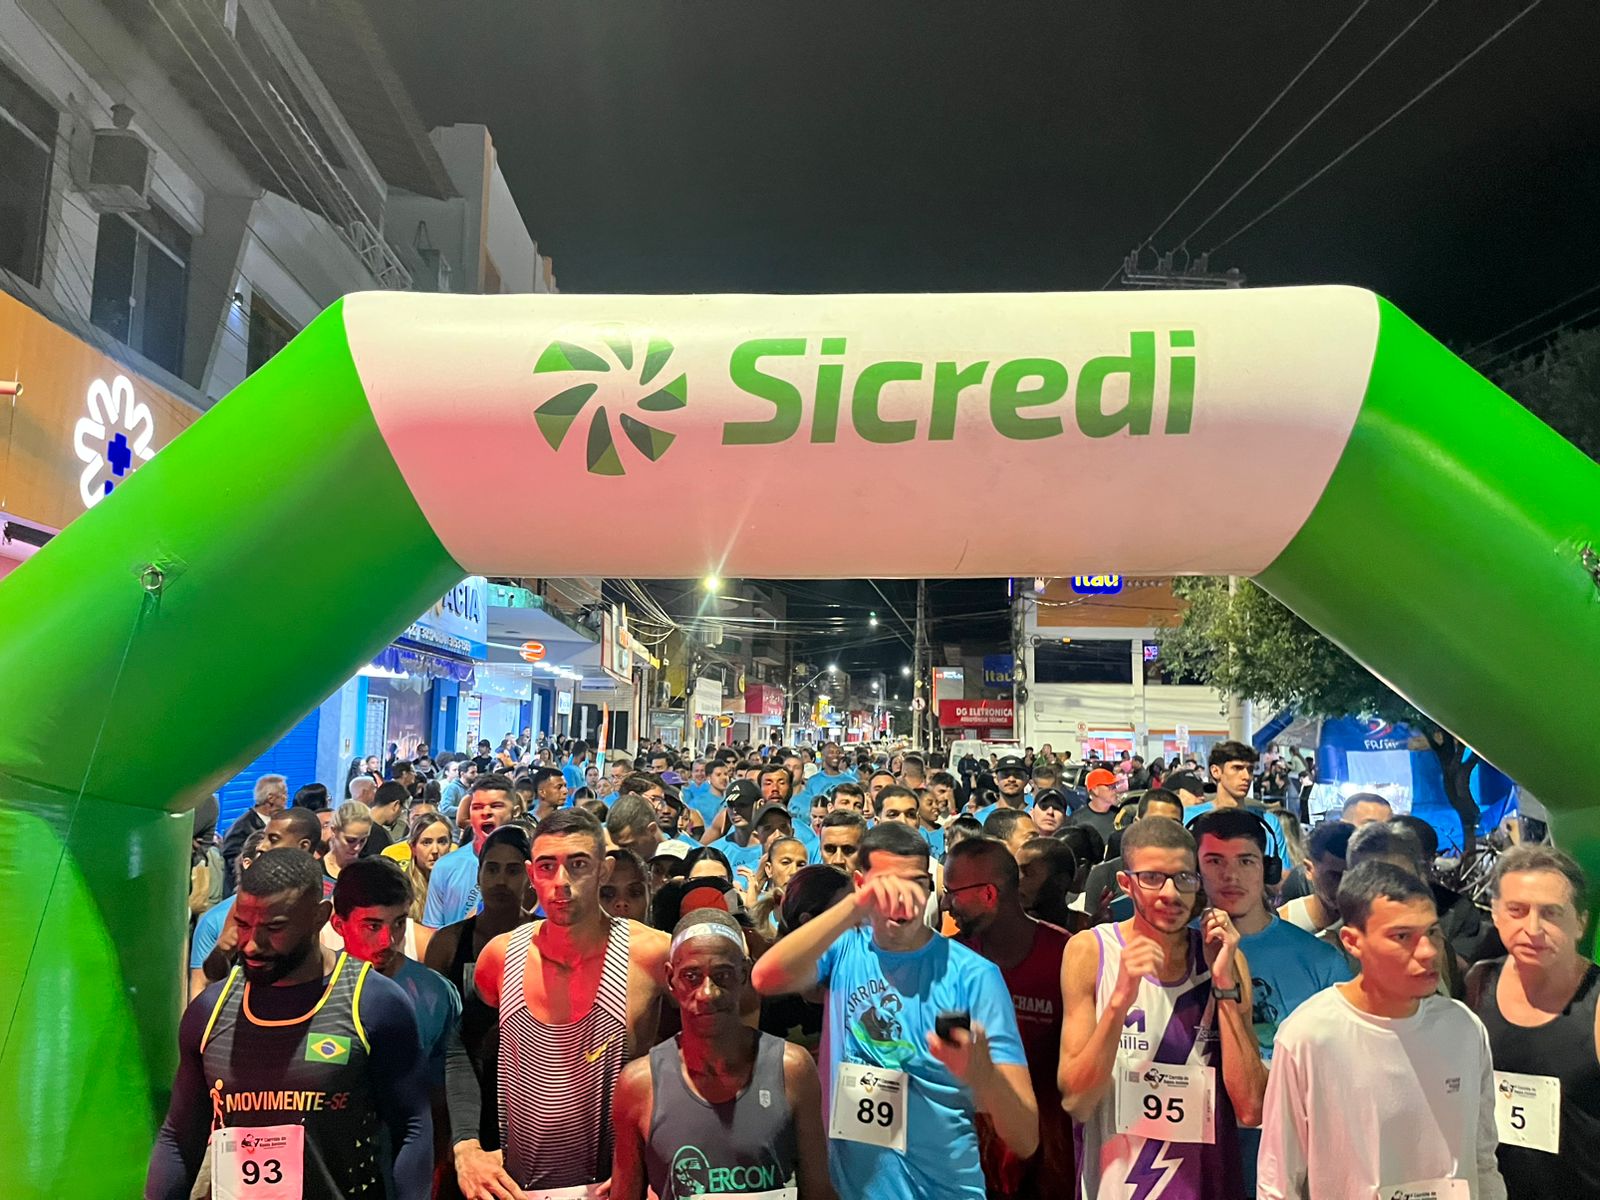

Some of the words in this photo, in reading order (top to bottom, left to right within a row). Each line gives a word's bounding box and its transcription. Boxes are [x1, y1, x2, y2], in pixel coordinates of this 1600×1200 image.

[722, 330, 1196, 445] Sicredi
[956, 707, 967, 716] DG
[226, 1091, 350, 1113] MOVIMENTE-SE
[857, 1098, 894, 1127] 89
[1143, 1094, 1184, 1123] 95
[1511, 1105, 1526, 1130] 5
[241, 1159, 283, 1185] 93
